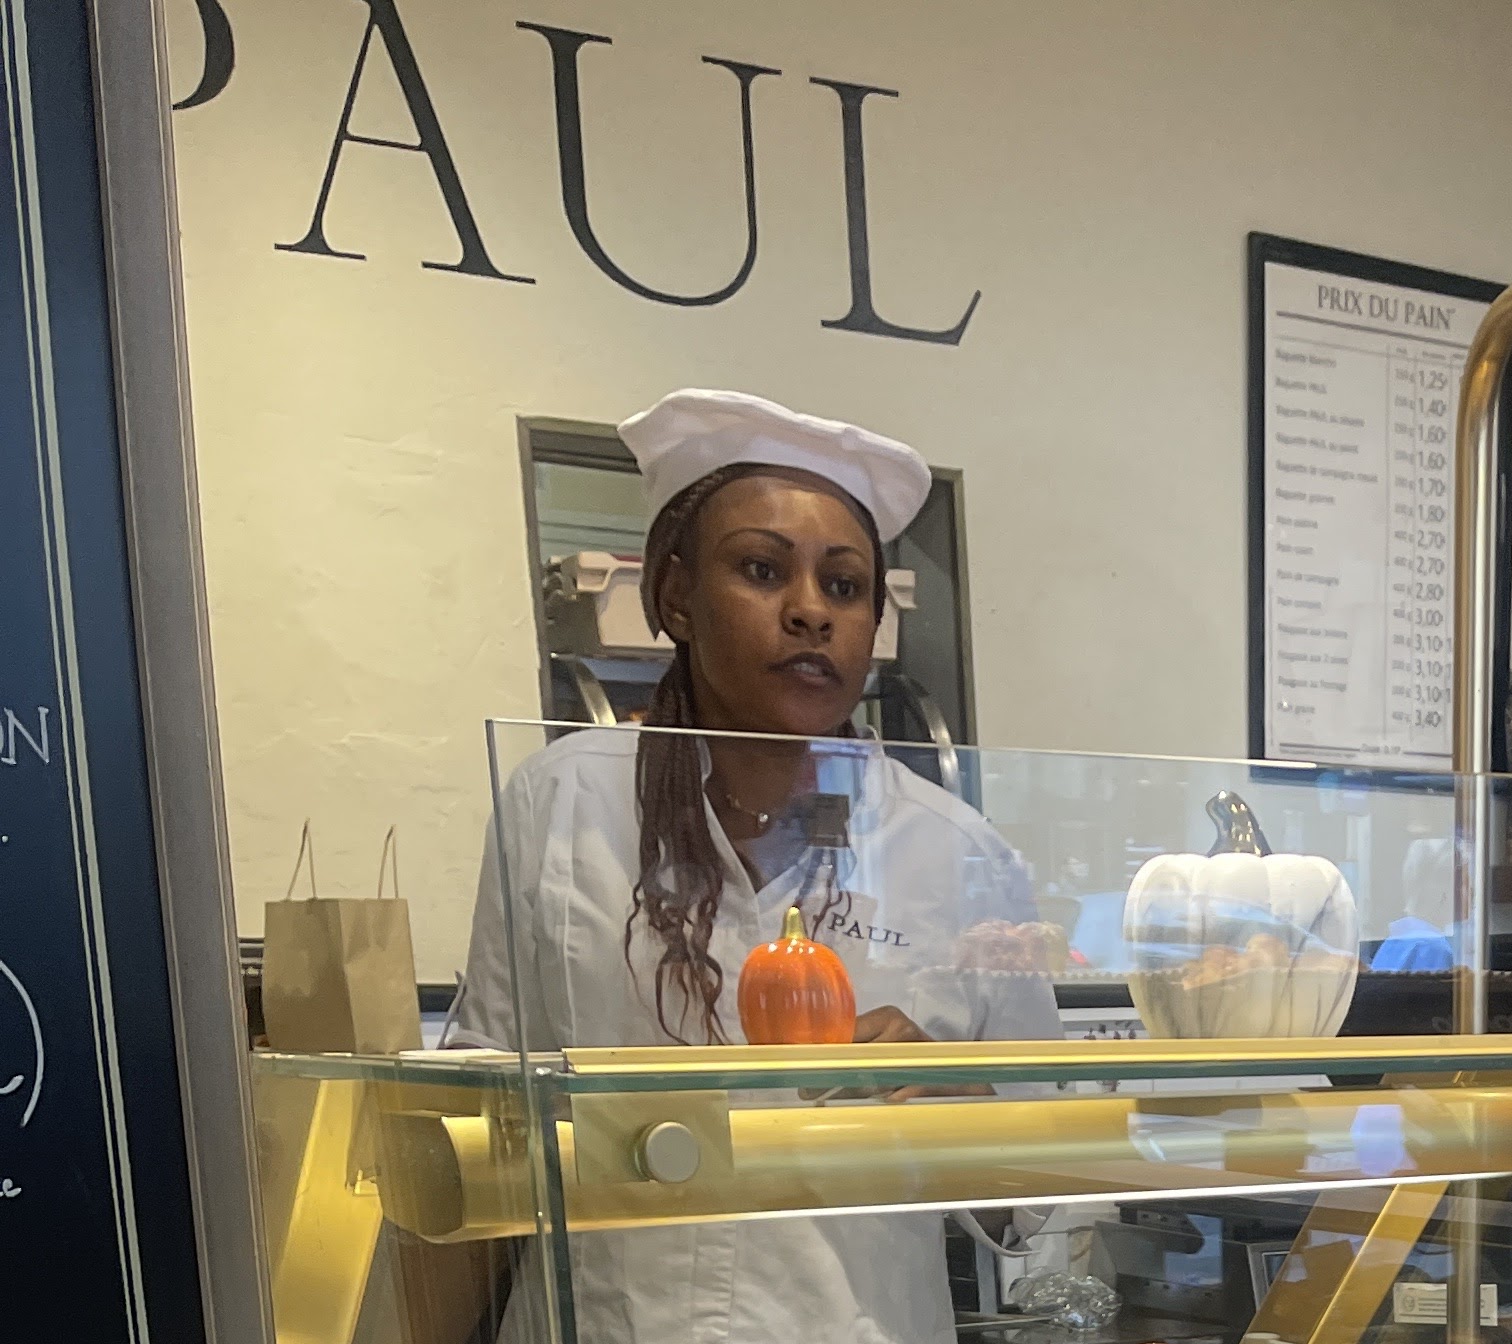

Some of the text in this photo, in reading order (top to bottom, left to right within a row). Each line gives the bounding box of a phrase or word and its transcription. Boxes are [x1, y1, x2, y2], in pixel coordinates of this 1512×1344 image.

[1317, 284, 1451, 330] PRIX DU PAIN
[0, 706, 49, 765] N
[827, 911, 911, 947] PAUL
